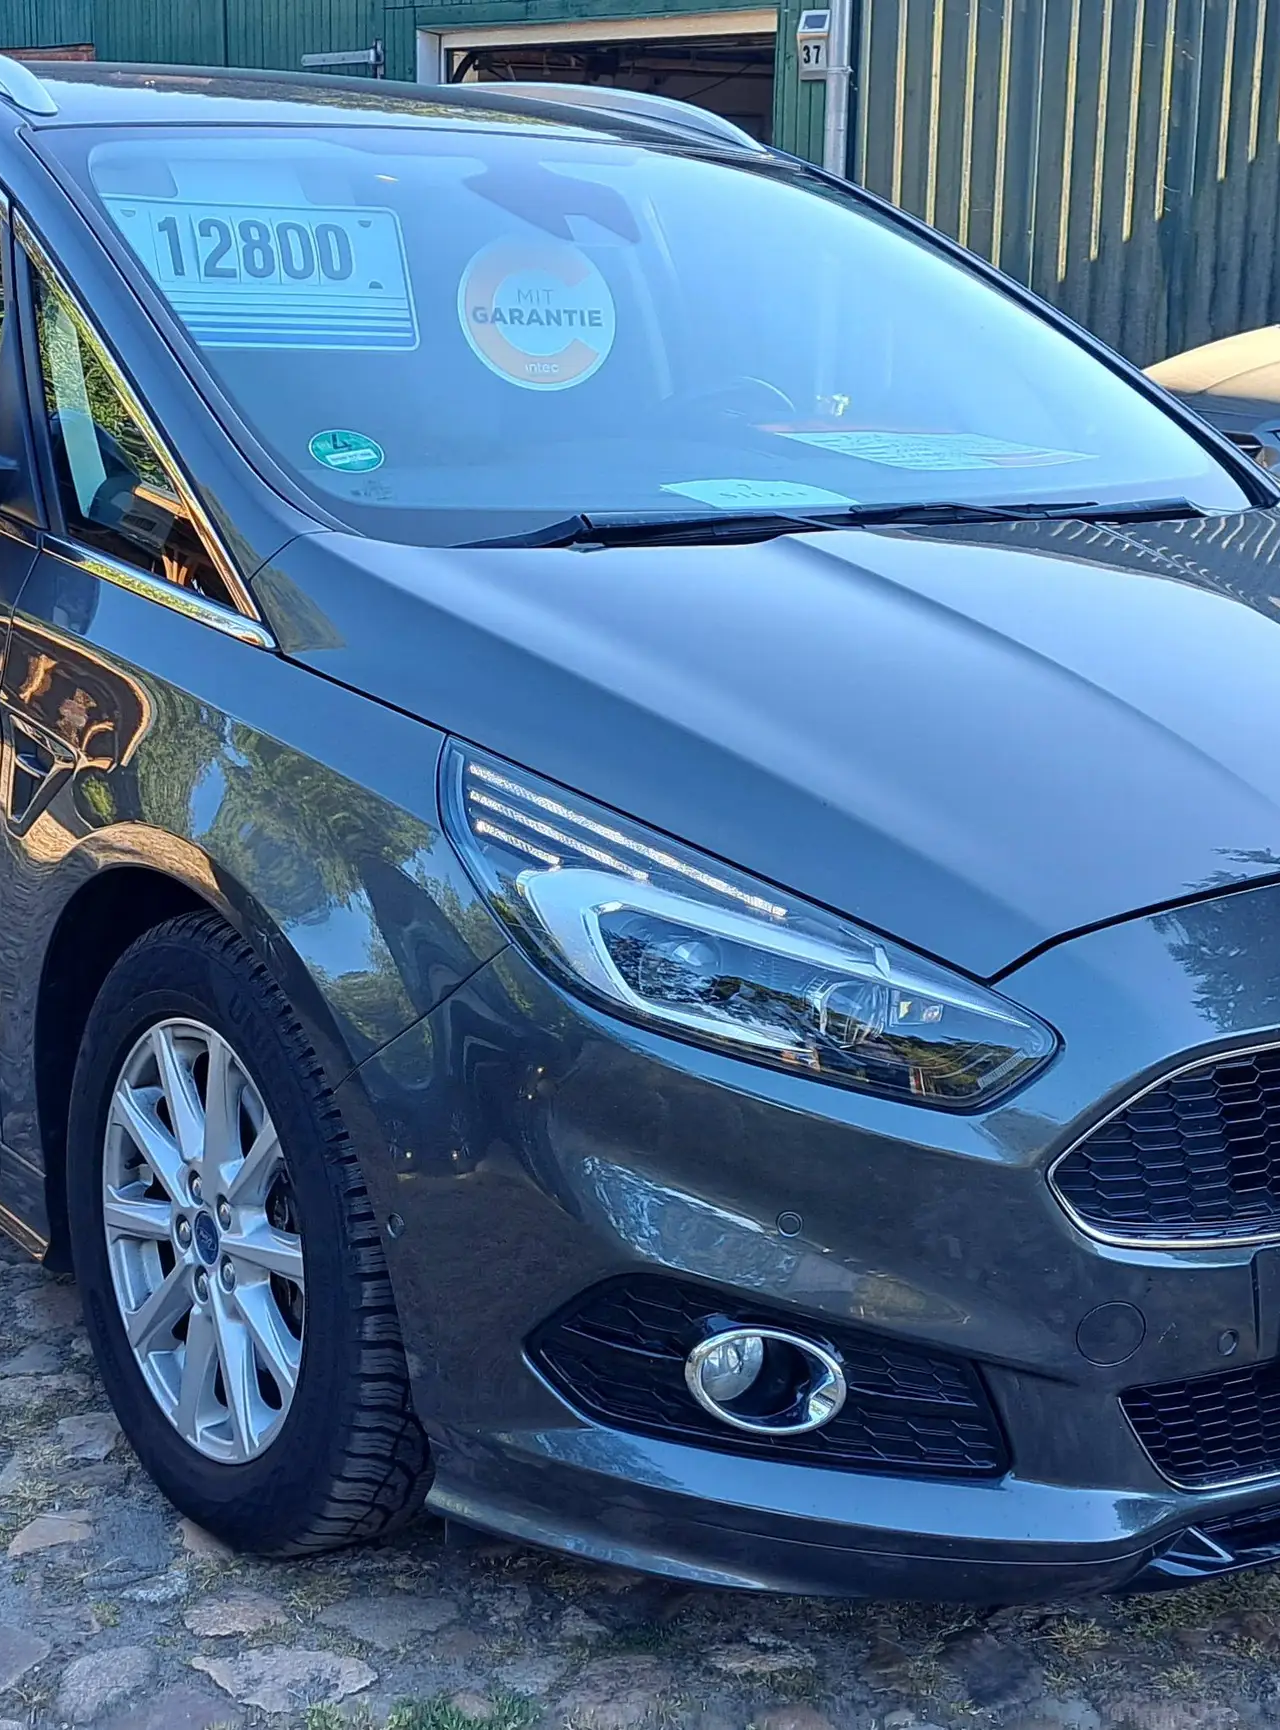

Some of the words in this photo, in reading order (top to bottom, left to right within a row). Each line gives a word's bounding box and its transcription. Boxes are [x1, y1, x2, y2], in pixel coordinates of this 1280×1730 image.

[803, 45, 821, 64] 37
[157, 215, 354, 281] 12800
[516, 288, 554, 306] MIT
[471, 306, 604, 327] GARANTIE
